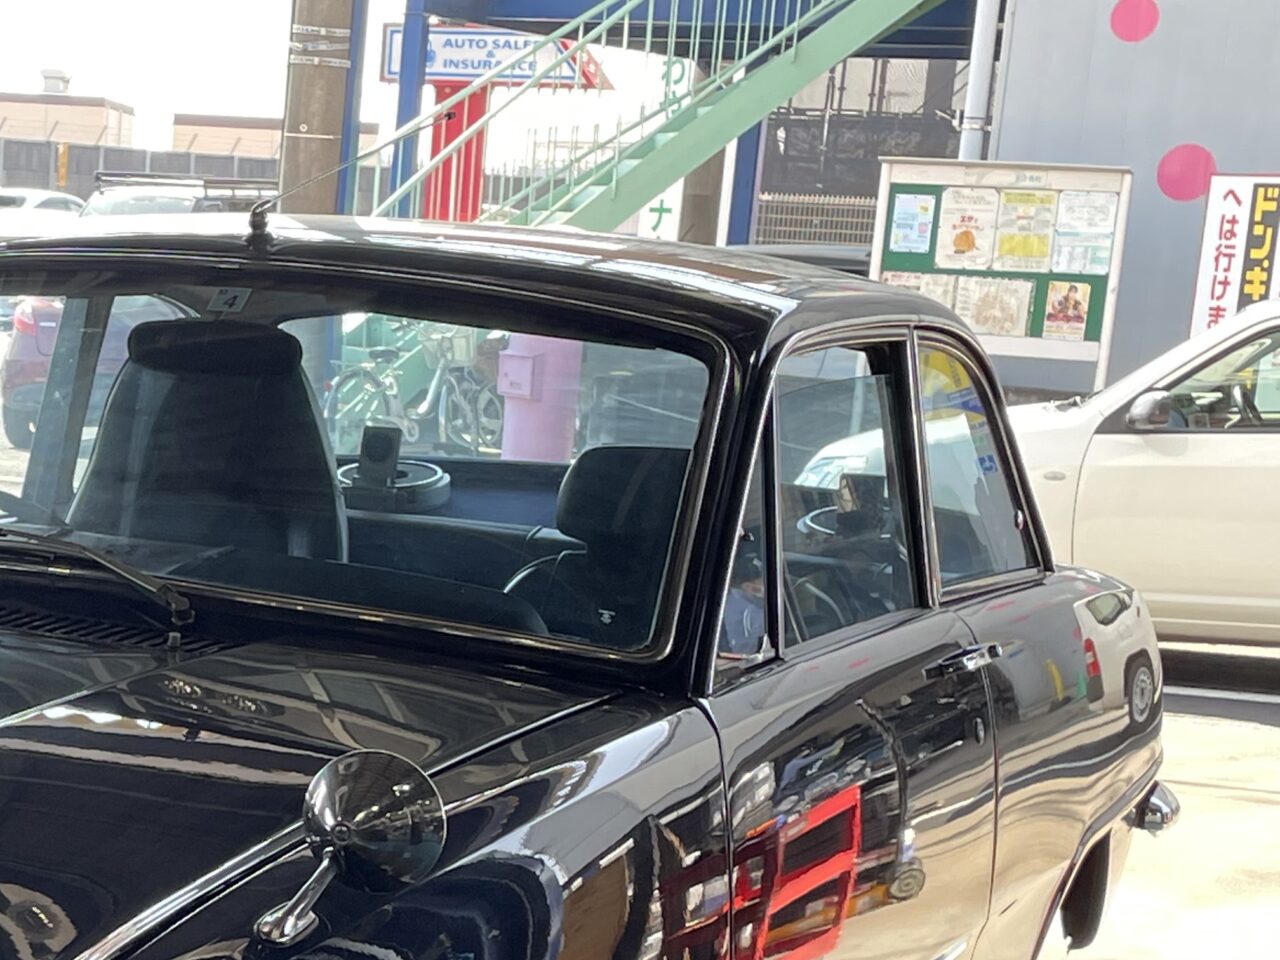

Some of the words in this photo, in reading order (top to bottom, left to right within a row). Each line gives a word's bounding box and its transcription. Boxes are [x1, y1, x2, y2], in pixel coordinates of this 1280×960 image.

[442, 38, 488, 49] AUTO
[485, 50, 496, 59] &
[442, 58, 537, 72] INSURACE
[223, 295, 239, 309] 4
